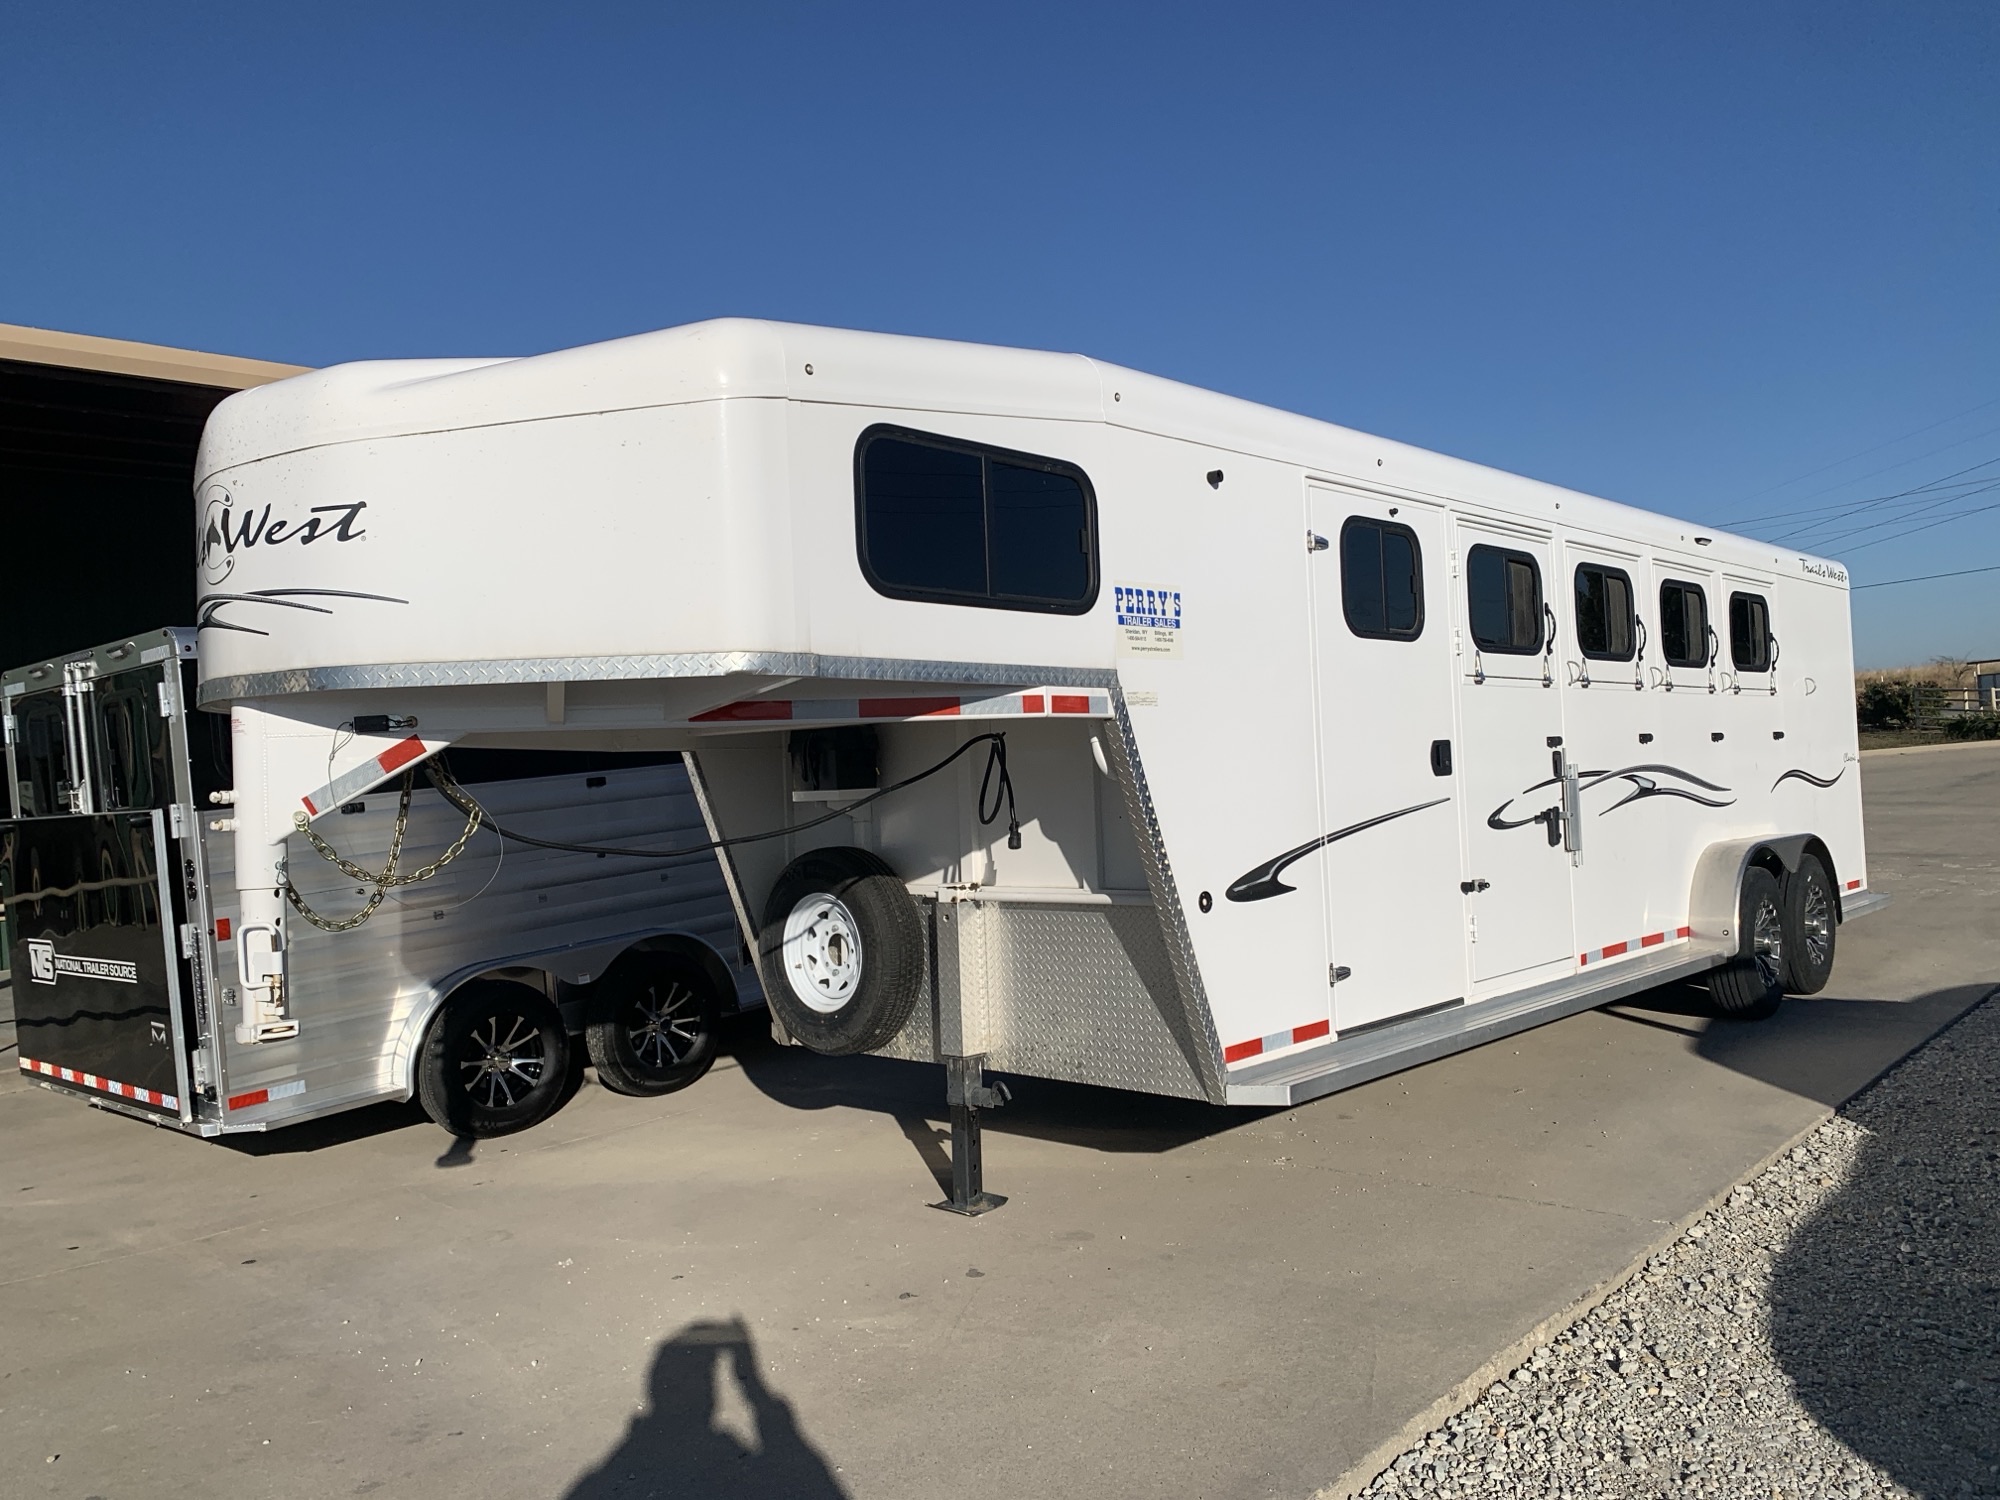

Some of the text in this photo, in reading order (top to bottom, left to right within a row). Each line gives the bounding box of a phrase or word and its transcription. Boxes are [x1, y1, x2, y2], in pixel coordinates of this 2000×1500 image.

[1798, 558, 1826, 577] Trails
[1114, 586, 1181, 618] PERRY'S
[1122, 615, 1176, 629] TRAILER SALES
[54, 958, 137, 979] NATIONAL TRAILER SOURCE
